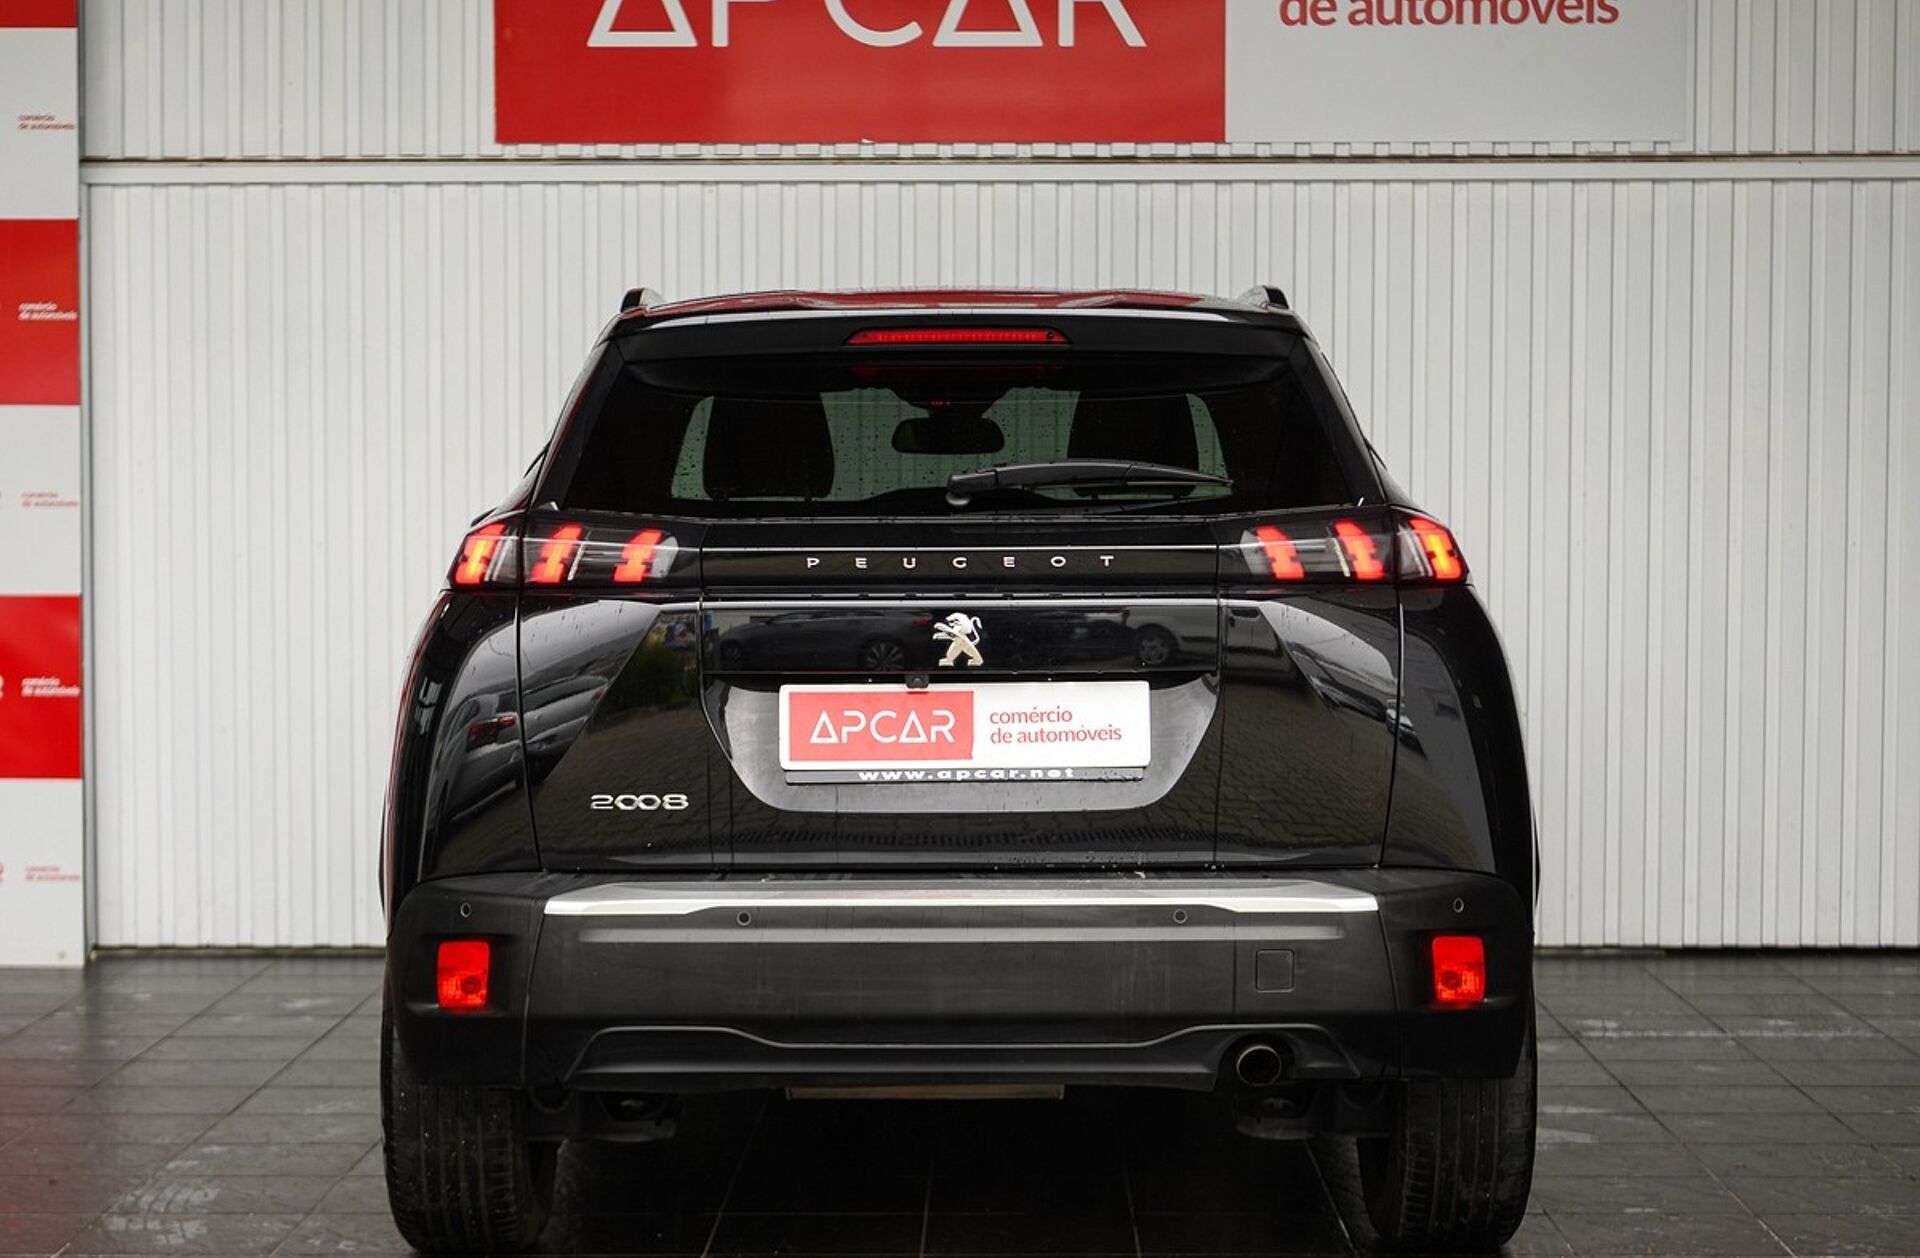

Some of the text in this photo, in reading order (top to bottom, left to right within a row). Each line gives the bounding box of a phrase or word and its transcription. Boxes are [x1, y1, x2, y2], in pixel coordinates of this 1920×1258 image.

[806, 554, 1115, 569] PEUGEOT
[989, 705, 1073, 724] comércio
[809, 709, 956, 744] APCAR
[990, 723, 1123, 744] de automóveis
[857, 768, 1075, 781] www.apcar.net
[590, 793, 689, 810] 2008
